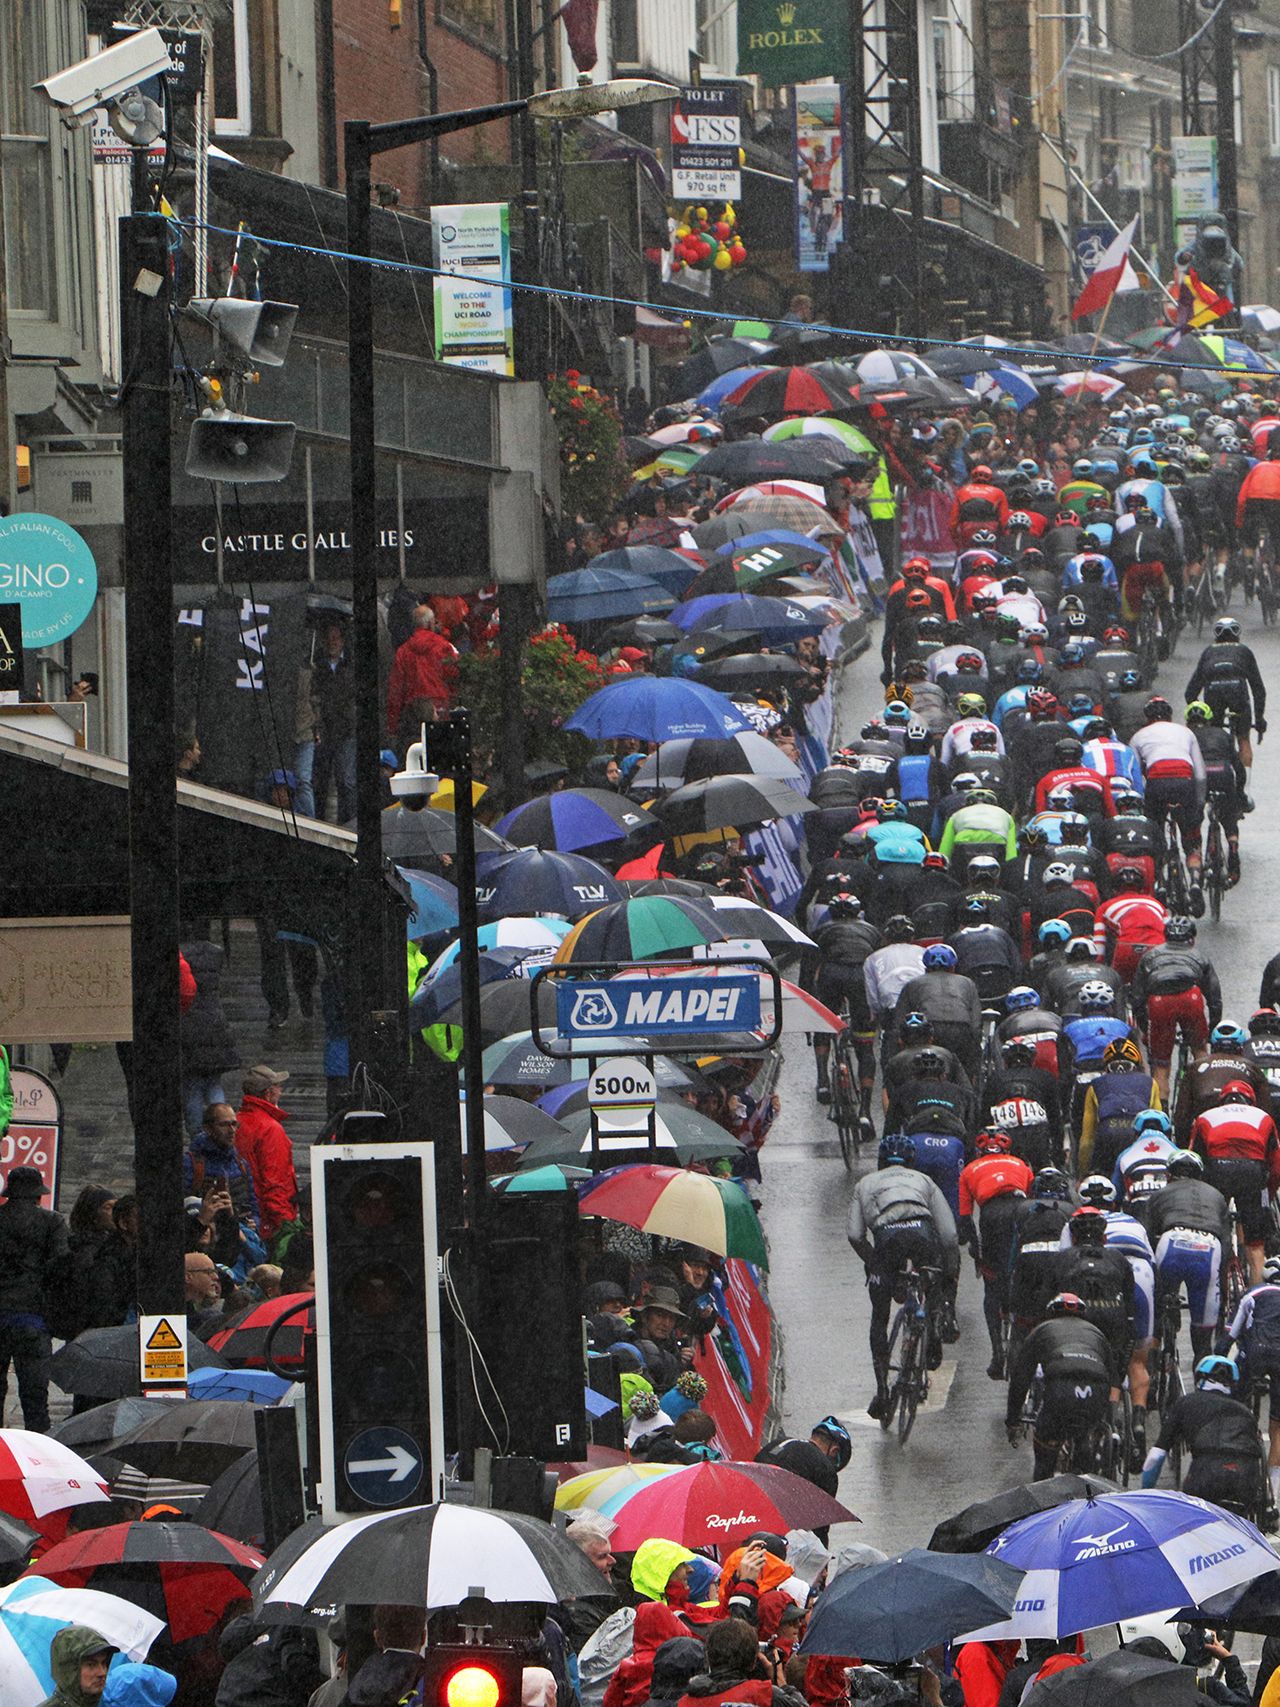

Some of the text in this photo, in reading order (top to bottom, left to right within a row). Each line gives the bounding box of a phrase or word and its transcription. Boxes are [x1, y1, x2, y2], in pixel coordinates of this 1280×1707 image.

[749, 28, 824, 49] ROLEX
[174, 41, 187, 54] of
[686, 91, 725, 100] TO LET
[105, 156, 132, 164] 01423
[680, 157, 733, 166] 01423 501 211
[695, 171, 717, 180] Retail
[719, 171, 736, 180] Unit
[687, 182, 726, 193] 970 sq ft
[453, 291, 491, 300] WELCOME
[472, 301, 486, 309] THE
[444, 330, 504, 339] CHAMPIONSHIPS
[10, 522, 51, 535] ITALIAN
[52, 527, 77, 553] FOOD
[201, 530, 414, 553] CASTLE GALLIES
[5, 590, 53, 598] D'ACAMPO
[60, 612, 73, 625] US
[625, 988, 741, 1024] MAPEI
[595, 1077, 650, 1095] 500M
[993, 1103, 1017, 1122] 148
[924, 1137, 949, 1147] CRO
[1074, 1540, 1137, 1562] MIZUNO
[1188, 1543, 1247, 1576] MIZUNO
[1014, 1599, 1045, 1612] UNO
